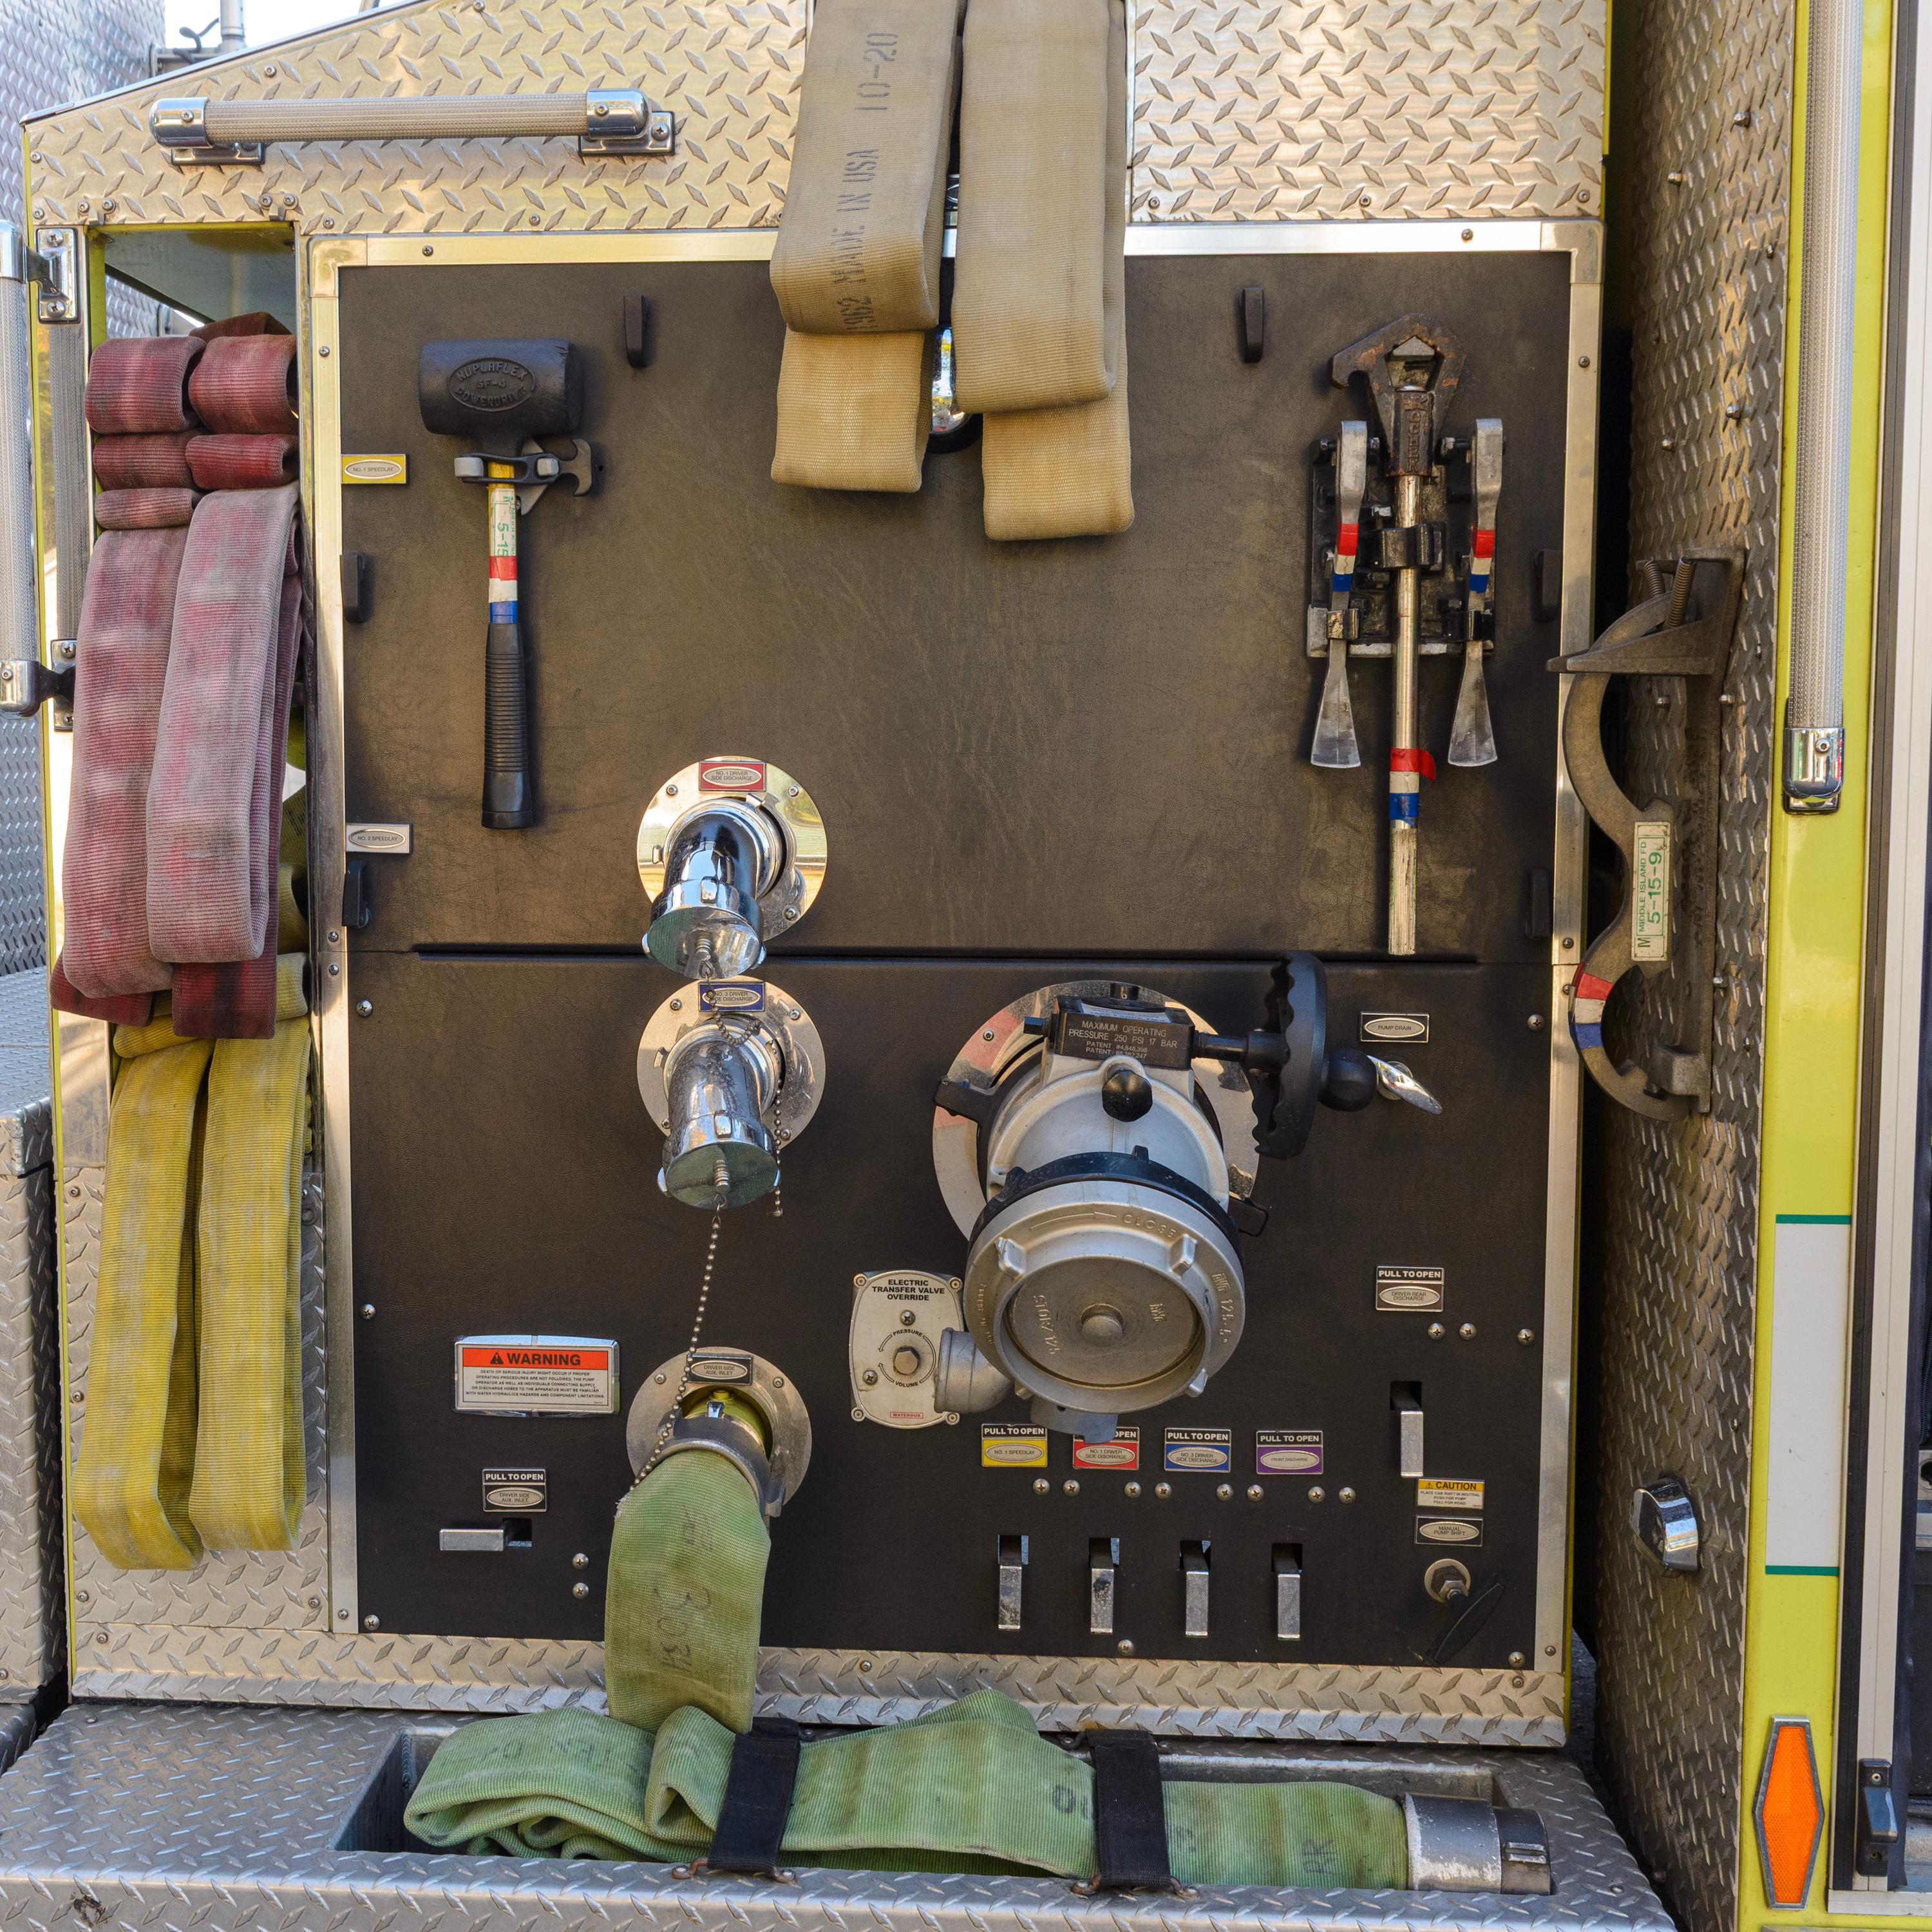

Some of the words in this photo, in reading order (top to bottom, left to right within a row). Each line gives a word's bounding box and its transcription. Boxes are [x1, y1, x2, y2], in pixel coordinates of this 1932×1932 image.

[855, 32, 899, 111] 10-20
[842, 149, 879, 183] USA
[837, 192, 871, 212] IN
[1640, 842, 1647, 853] FD
[1647, 852, 1662, 924] 5-15-9
[1081, 1020, 1118, 1032] MAXIMUM
[1122, 1025, 1167, 1037] OPERATING
[1068, 1028, 1109, 1041] PRESSURE
[1113, 1034, 1128, 1043] 250
[1132, 1036, 1144, 1045] PSI
[1149, 1037, 1157, 1046] 17
[1160, 1039, 1177, 1048] BAR
[1086, 1041, 1112, 1049] PATENT
[1086, 1047, 1112, 1056] PATENT
[1122, 1215, 1177, 1238] CLOSE
[893, 1329, 923, 1338] PRESSURE
[507, 1353, 581, 1366] WARNING
[1435, 1481, 1477, 1490] CAUTION
